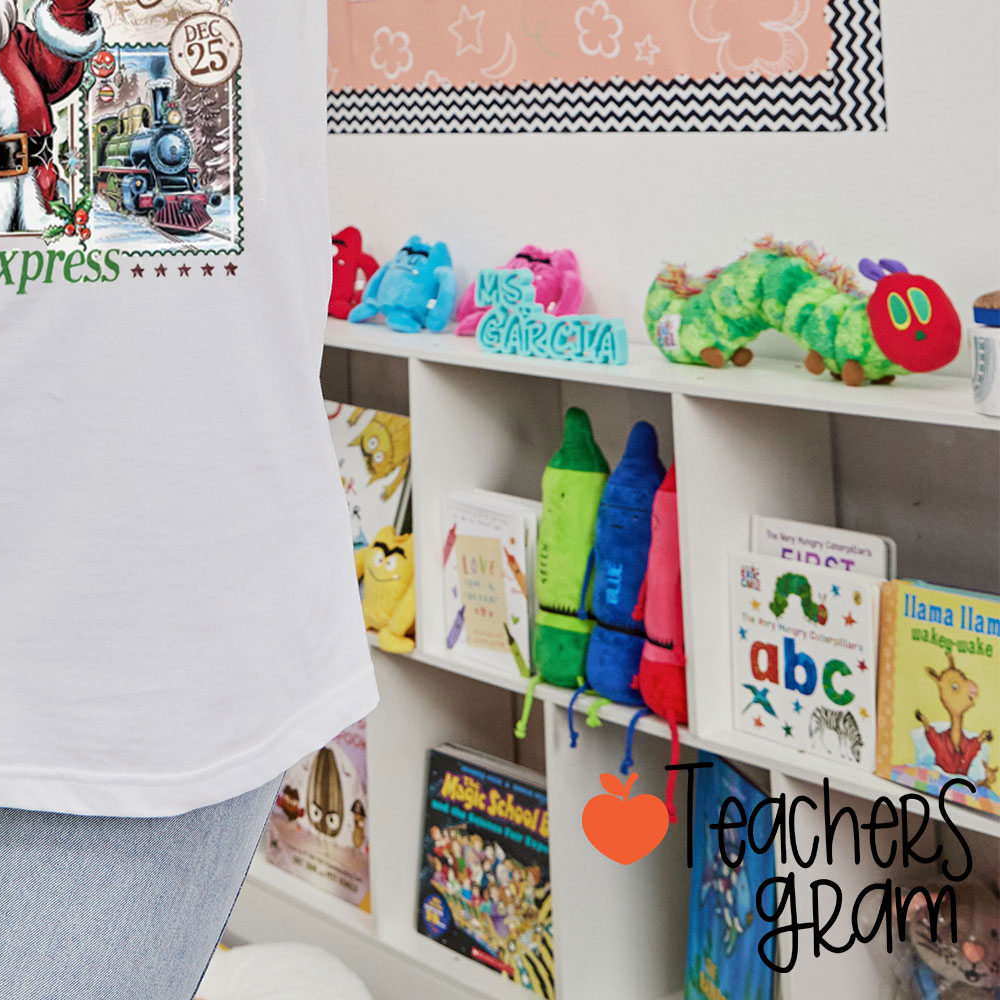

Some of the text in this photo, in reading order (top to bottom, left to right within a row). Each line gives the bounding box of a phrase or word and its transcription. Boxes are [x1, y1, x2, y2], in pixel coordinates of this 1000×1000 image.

[184, 19, 222, 42] DEC
[187, 37, 229, 77] 25
[479, 312, 618, 364] GARCIA
[904, 593, 954, 628] llama
[911, 626, 994, 658] wakey-wake
[750, 636, 856, 706] abc
[440, 771, 487, 811] Magic
[486, 788, 541, 833] School
